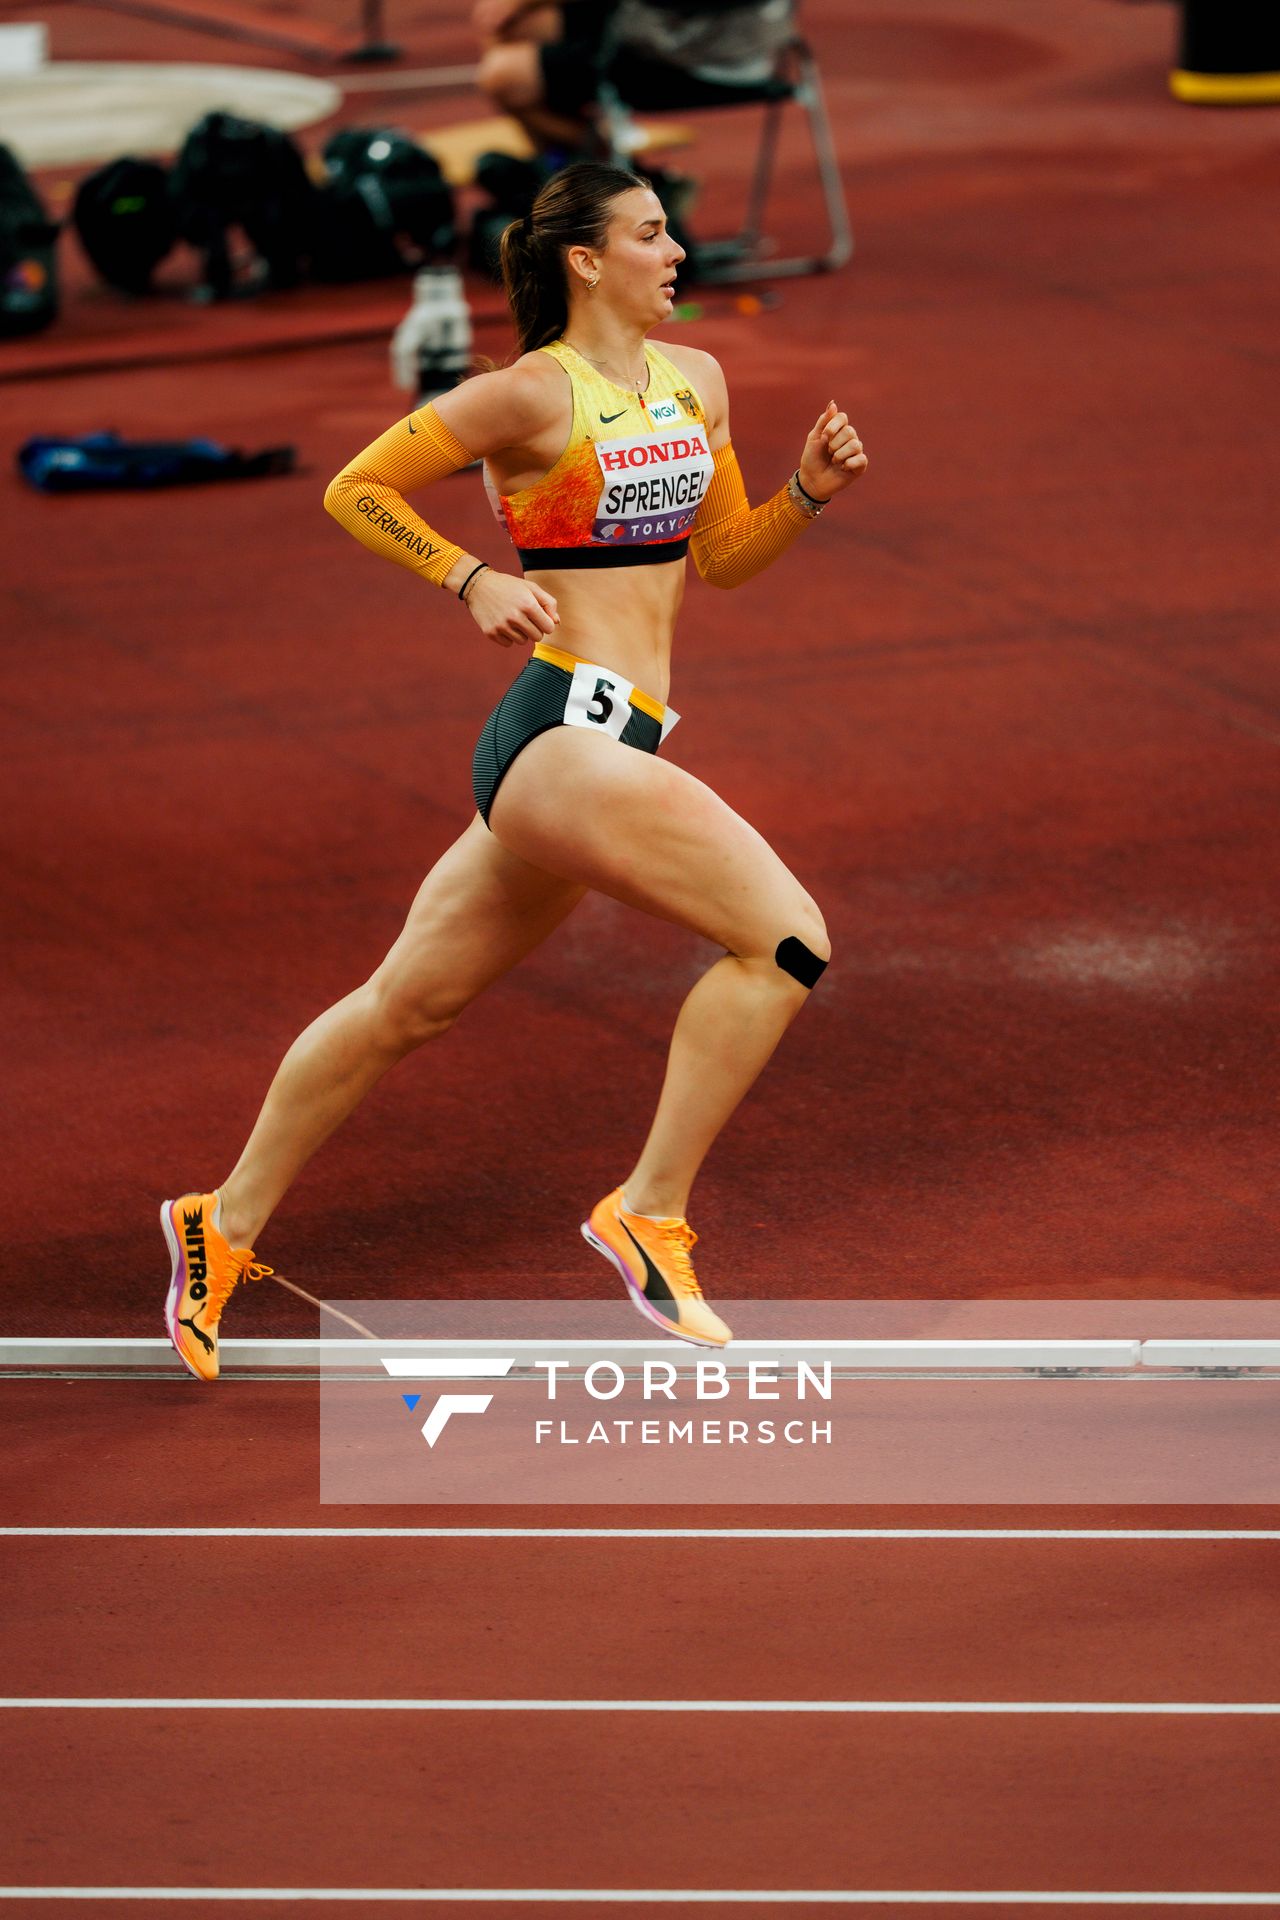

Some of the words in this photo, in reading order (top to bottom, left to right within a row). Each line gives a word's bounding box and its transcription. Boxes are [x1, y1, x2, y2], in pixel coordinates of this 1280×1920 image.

[650, 404, 676, 420] WGV
[600, 436, 707, 471] HONDA
[606, 471, 704, 514] SPRENGEL
[356, 496, 440, 560] GERMANY
[586, 678, 615, 724] 5
[183, 1203, 207, 1301] NITRO
